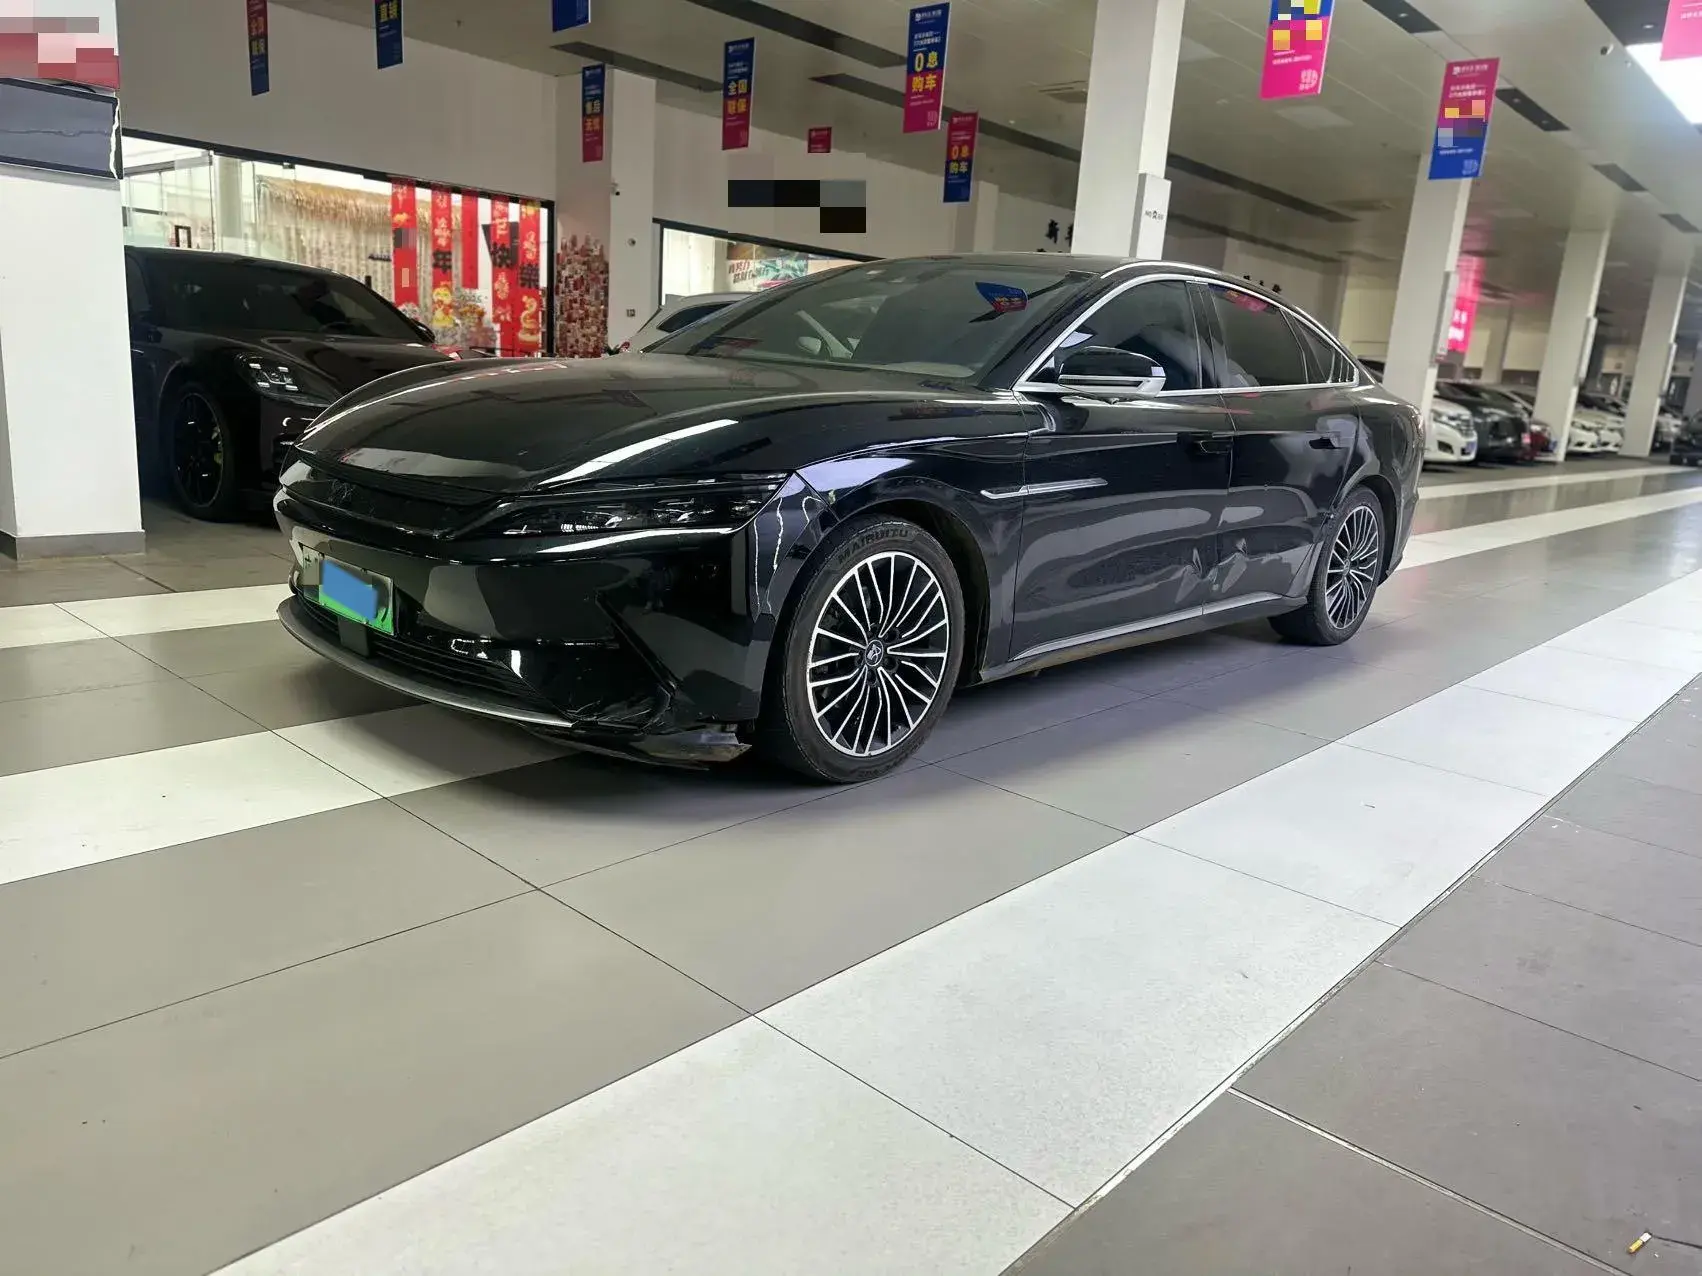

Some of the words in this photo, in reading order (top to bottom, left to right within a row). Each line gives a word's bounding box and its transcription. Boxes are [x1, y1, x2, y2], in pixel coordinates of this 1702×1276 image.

[915, 51, 938, 72] 0息
[728, 79, 748, 95] 全国
[912, 74, 937, 92] 购车
